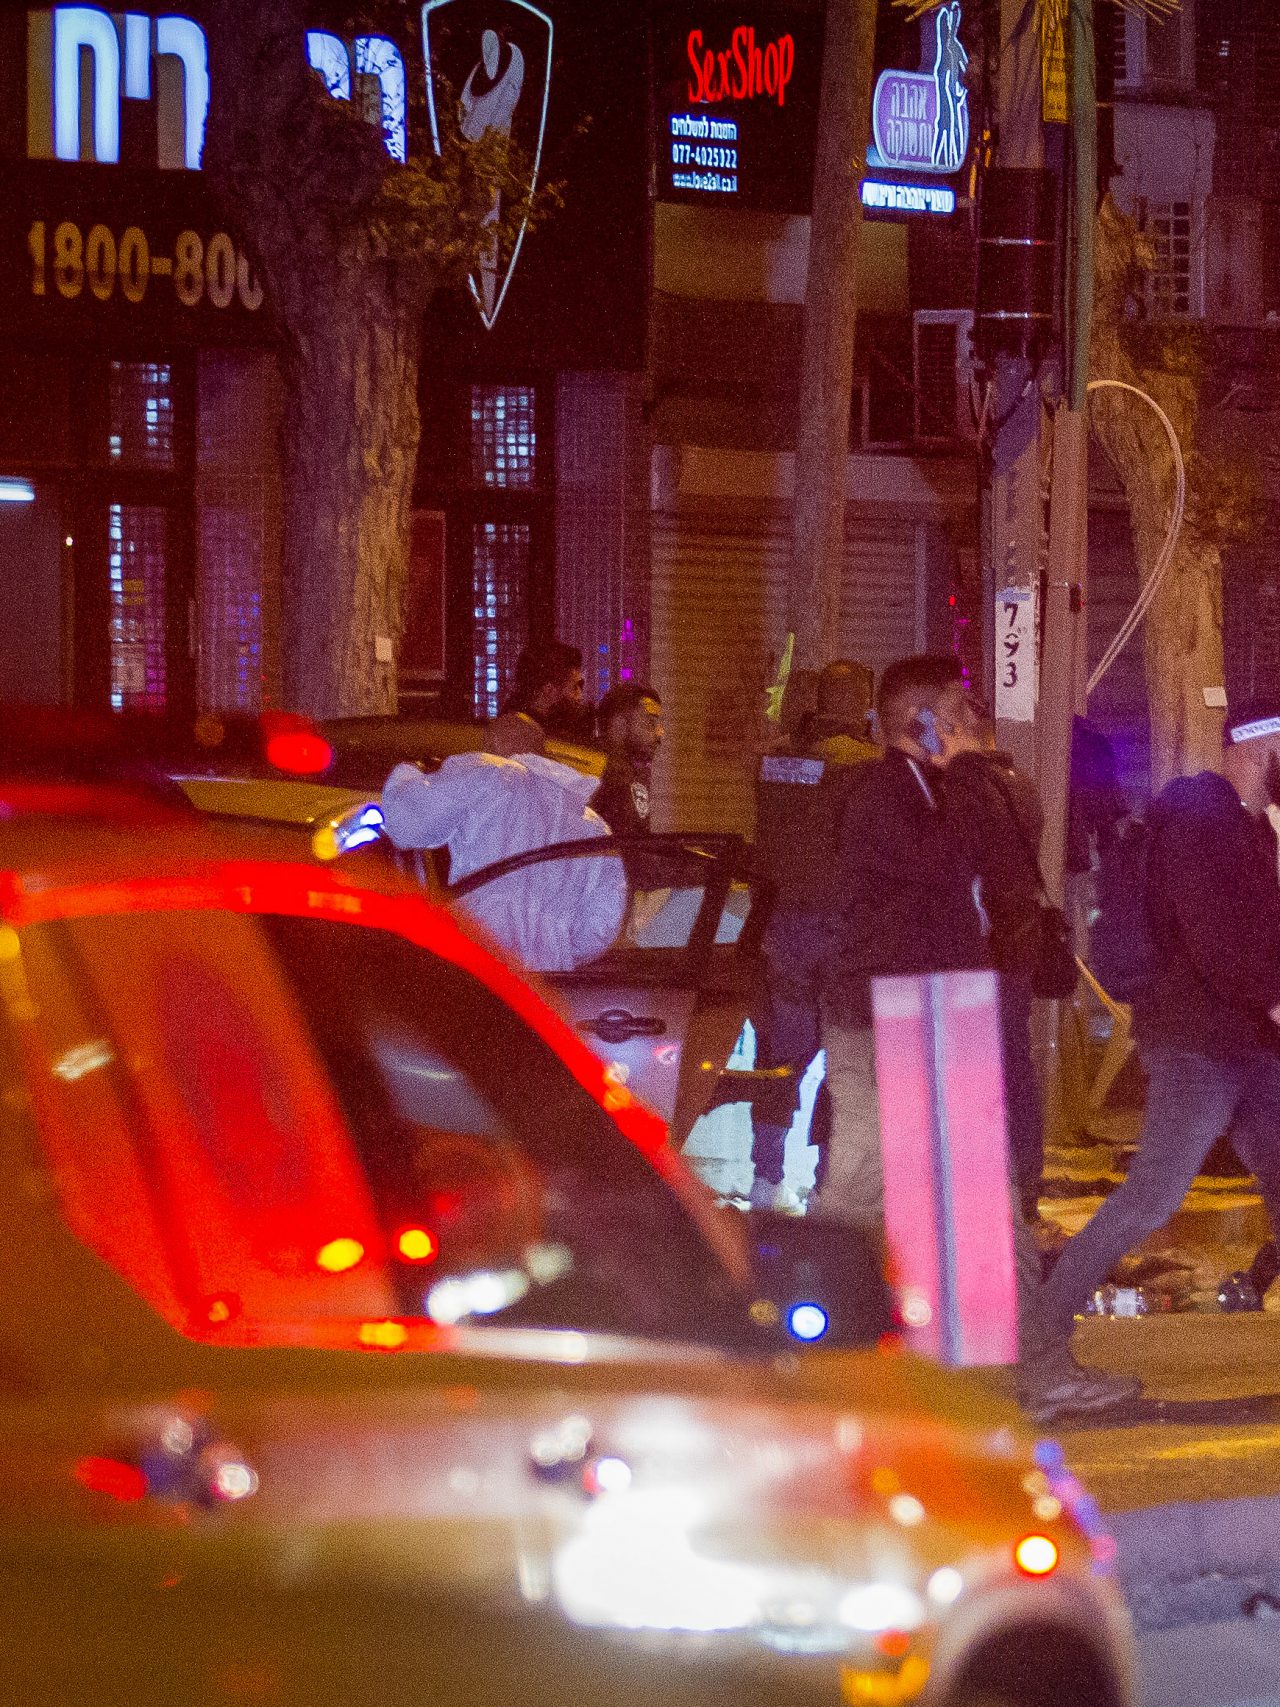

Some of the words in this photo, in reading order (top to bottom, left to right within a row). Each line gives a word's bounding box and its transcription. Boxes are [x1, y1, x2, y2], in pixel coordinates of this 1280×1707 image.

[687, 25, 794, 106] SexShop
[891, 82, 927, 120] אהבה
[671, 113, 709, 138] למשלוחים
[886, 120, 933, 161] ותשוקה
[1003, 602, 1020, 688] 793
